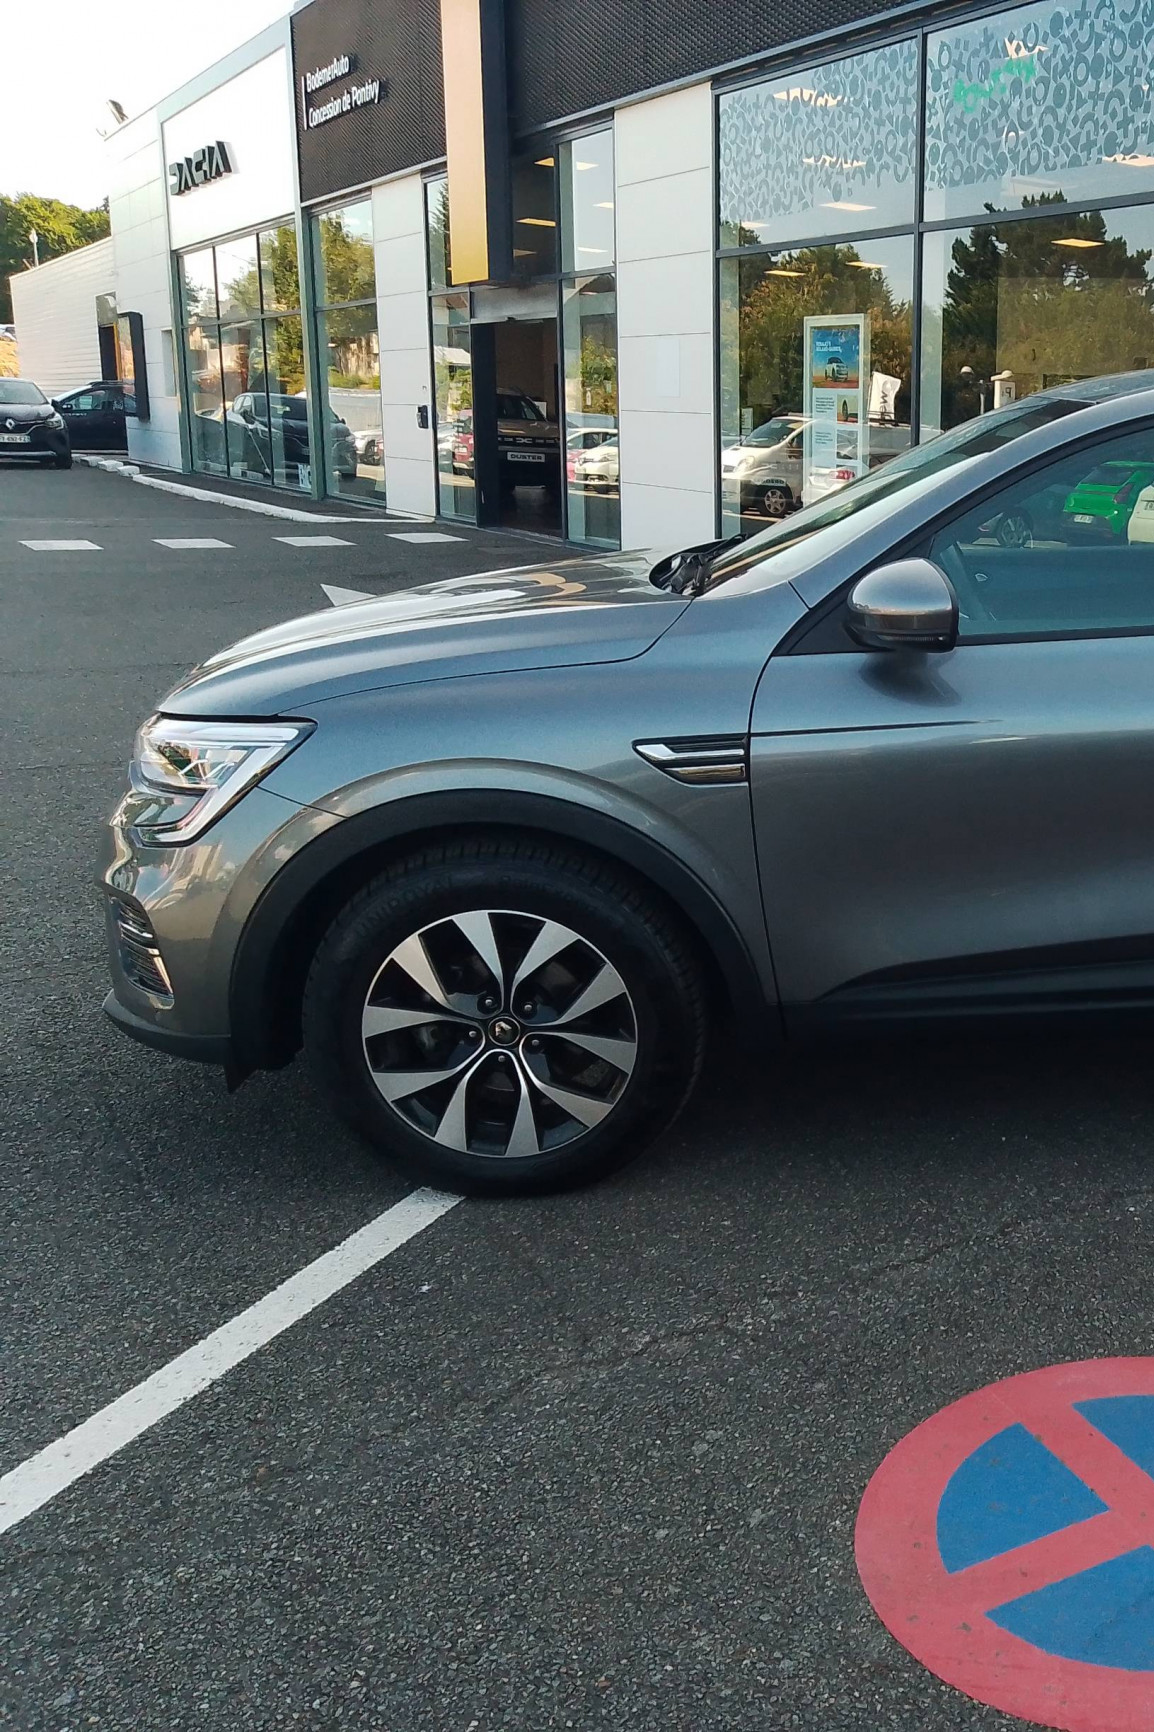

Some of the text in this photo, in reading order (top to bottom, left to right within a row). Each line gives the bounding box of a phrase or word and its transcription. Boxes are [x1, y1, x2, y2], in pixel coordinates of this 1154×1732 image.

[306, 54, 350, 93] BodemerAuto
[308, 78, 380, 128] Concession de Pontivy
[168, 140, 233, 196] DACIA
[510, 453, 543, 461] DUSTER
